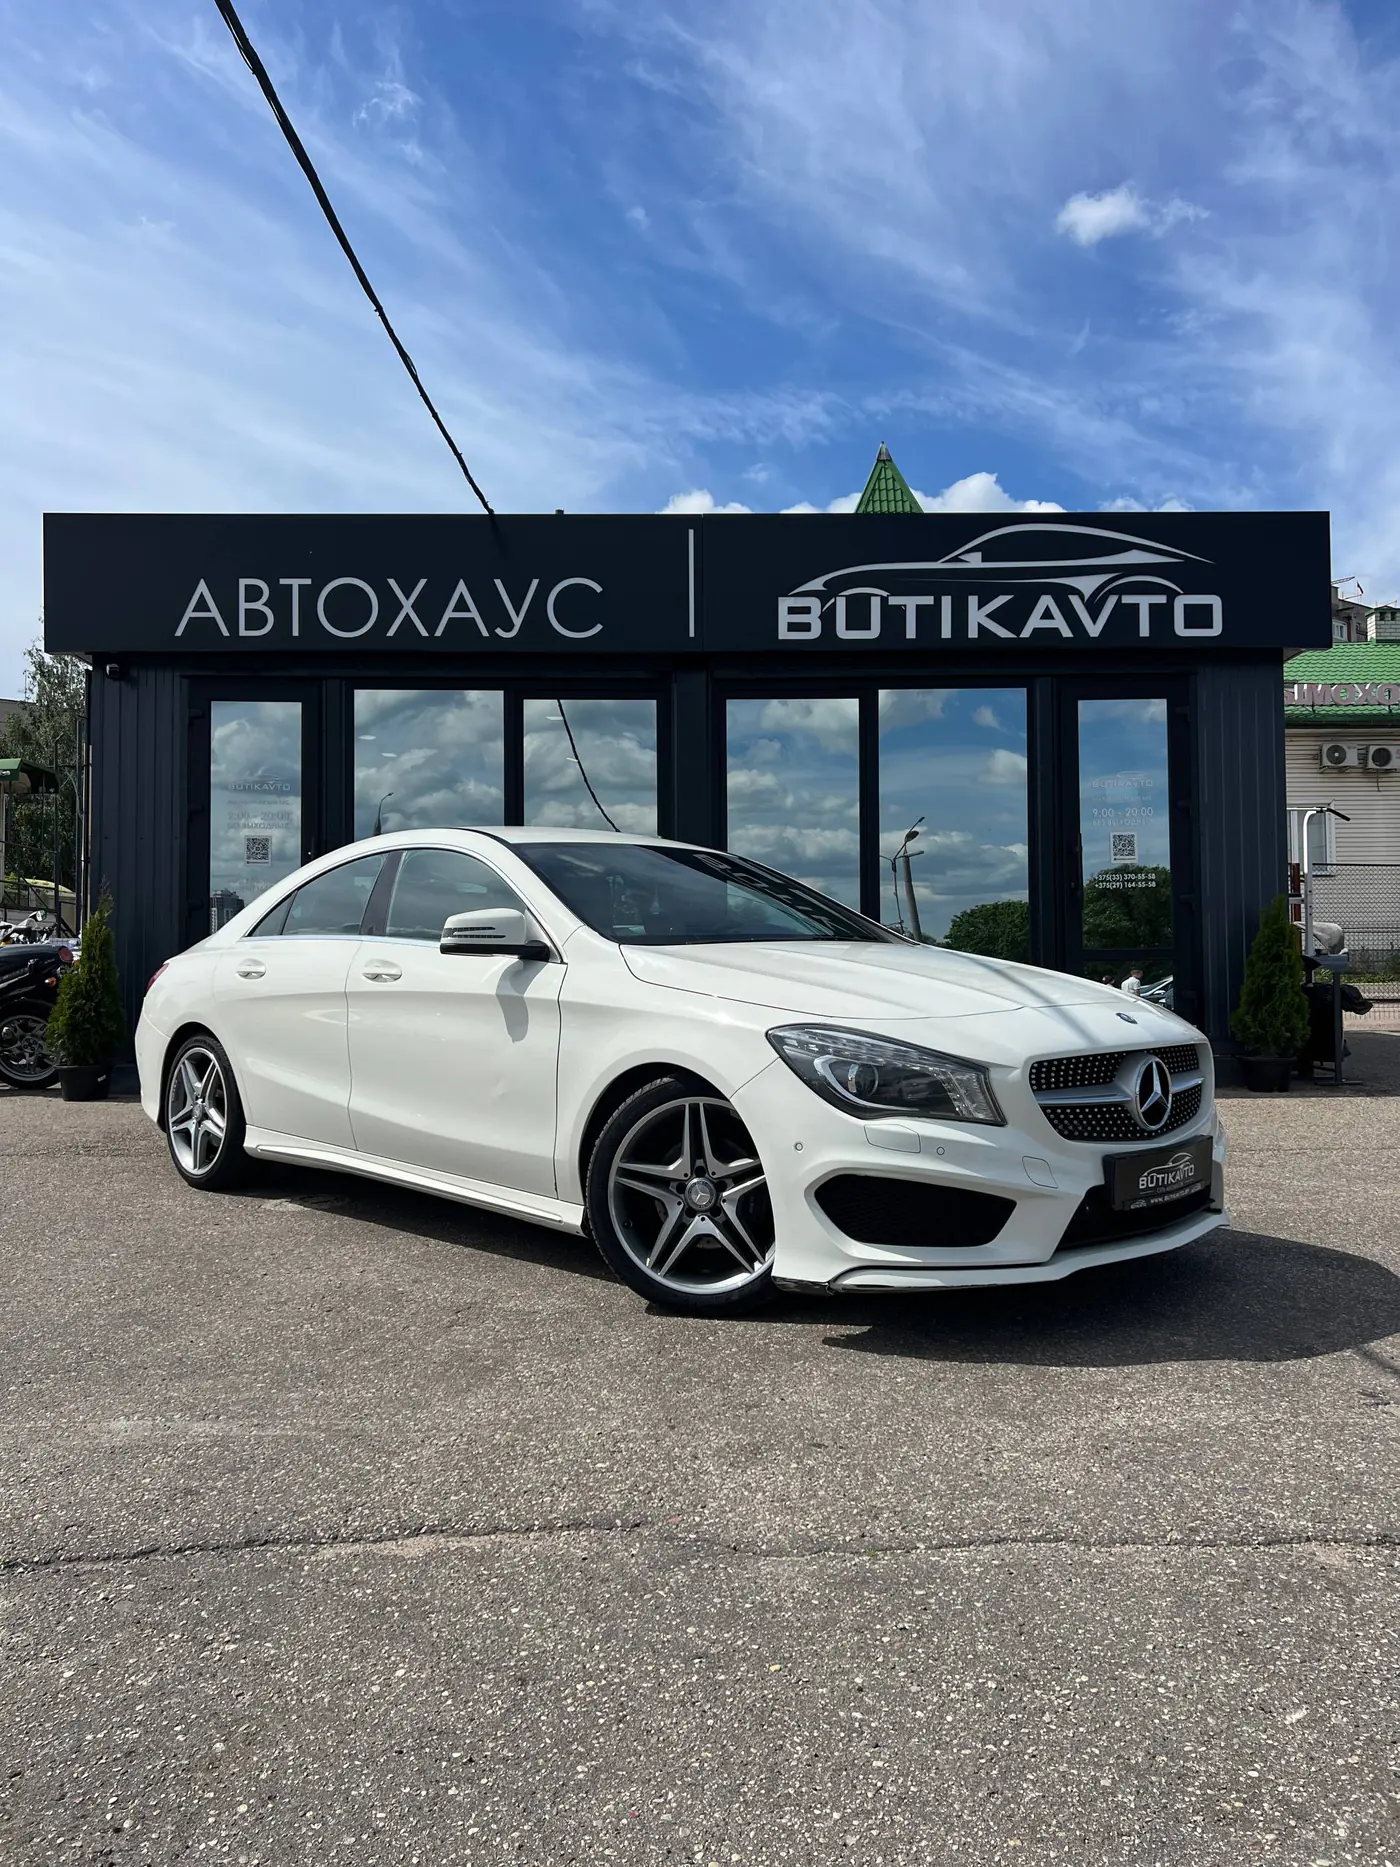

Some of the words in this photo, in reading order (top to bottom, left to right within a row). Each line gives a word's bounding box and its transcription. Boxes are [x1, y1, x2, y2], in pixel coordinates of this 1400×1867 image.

[174, 577, 604, 639] АВТОХАУС
[777, 594, 1223, 640] BUTIKAVTO
[228, 783, 291, 791] BUTIKAVTO
[1092, 779, 1154, 788] BUTIKAVTO
[1092, 807, 1115, 818] 9:00
[1125, 806, 1154, 817] 20:00
[1095, 874, 1123, 882] +375(33)
[1123, 873, 1156, 881] 370-55-58
[1139, 1164, 1195, 1189] BUTIKAVTO
